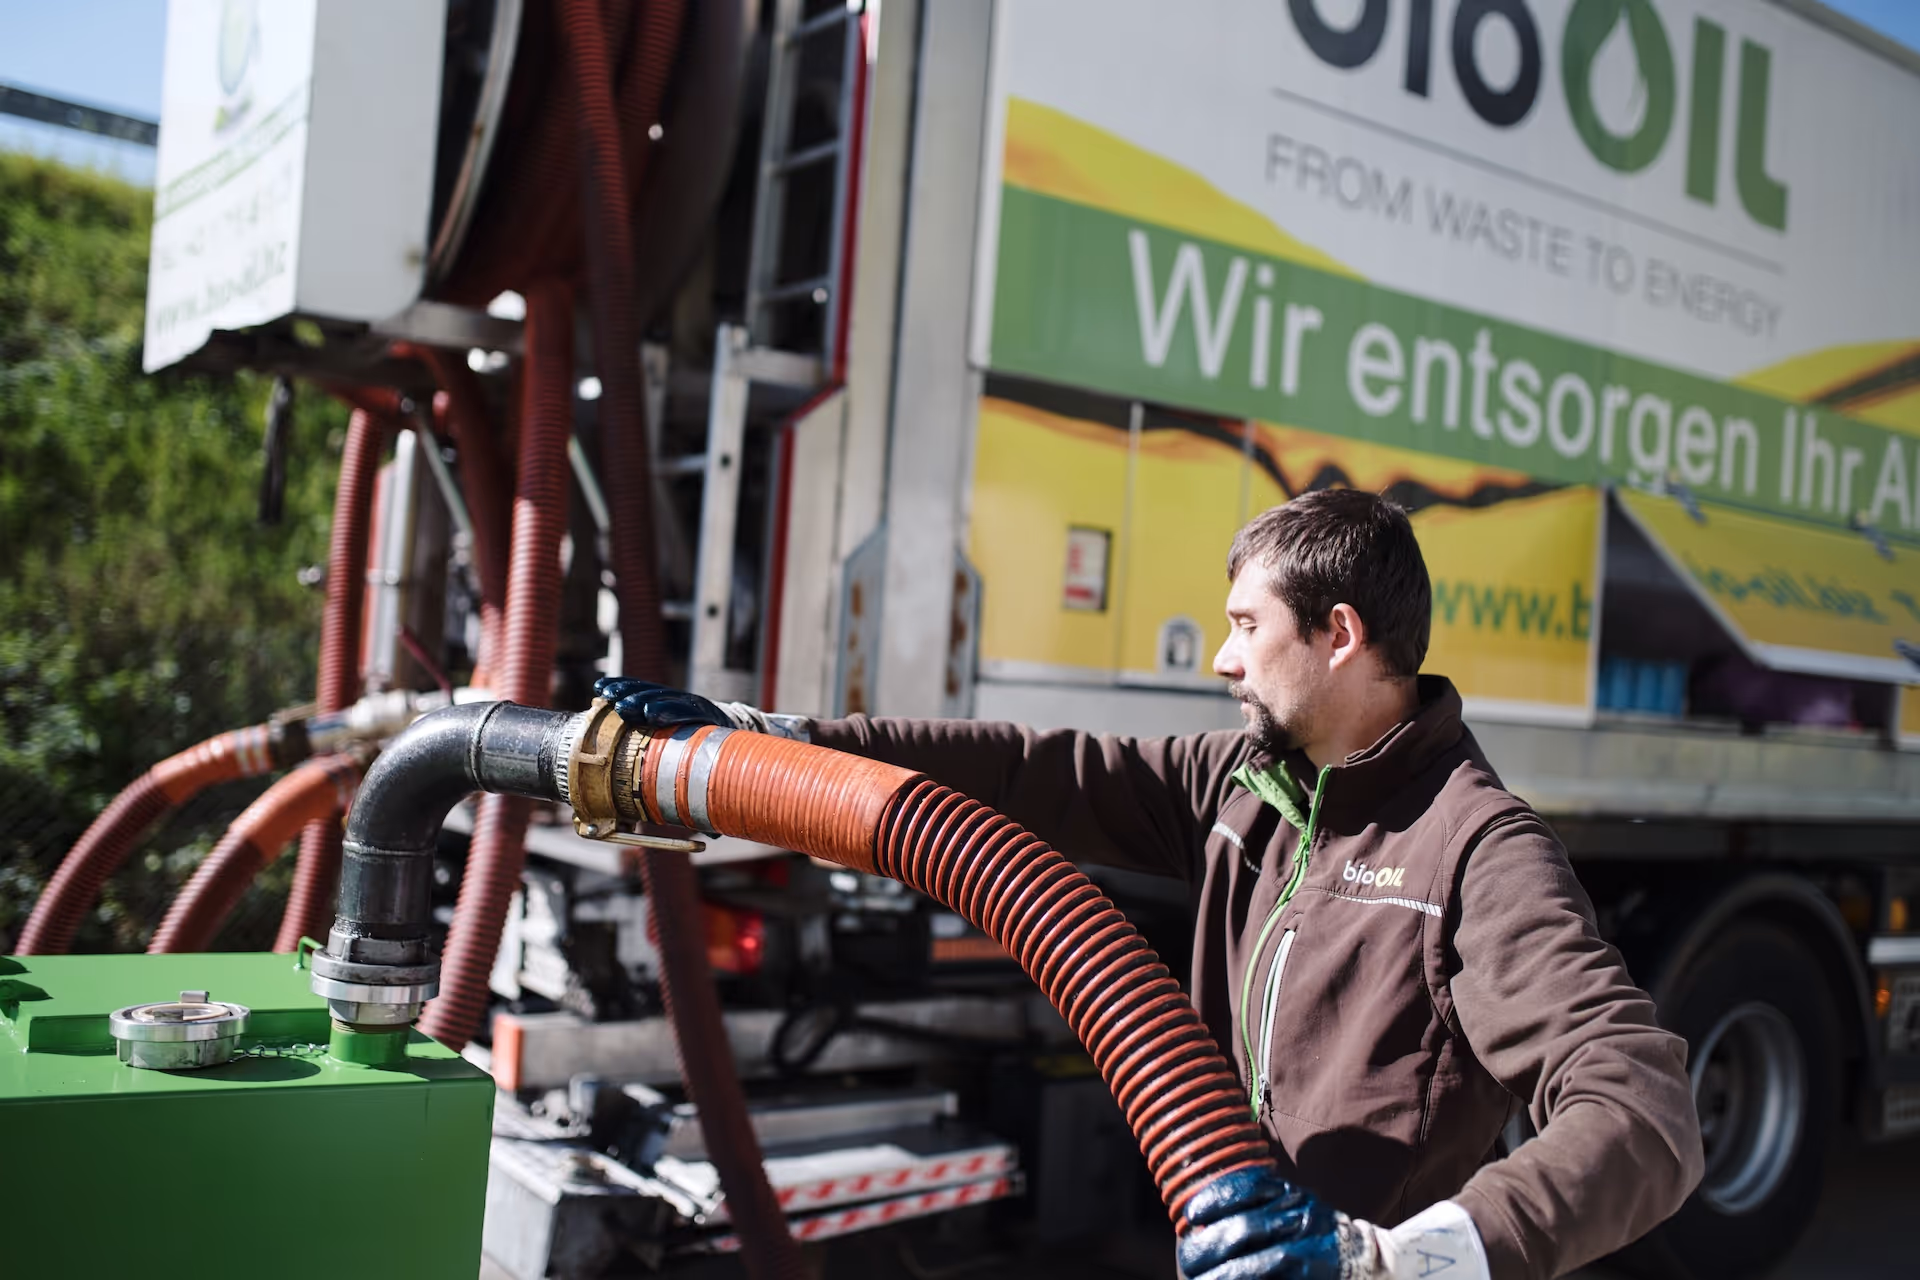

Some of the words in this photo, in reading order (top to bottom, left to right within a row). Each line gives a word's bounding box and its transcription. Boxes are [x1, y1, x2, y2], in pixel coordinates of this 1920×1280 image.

[1265, 133, 1413, 225] FROM
[1424, 184, 1573, 278] WASTE
[1586, 235, 1635, 295] TO
[1646, 255, 1781, 341] ENERGY
[1128, 228, 1324, 396] Wir
[1347, 320, 1758, 498] entsorgen
[1779, 406, 1864, 516] Ihr
[1342, 860, 1405, 887] bioOIL
